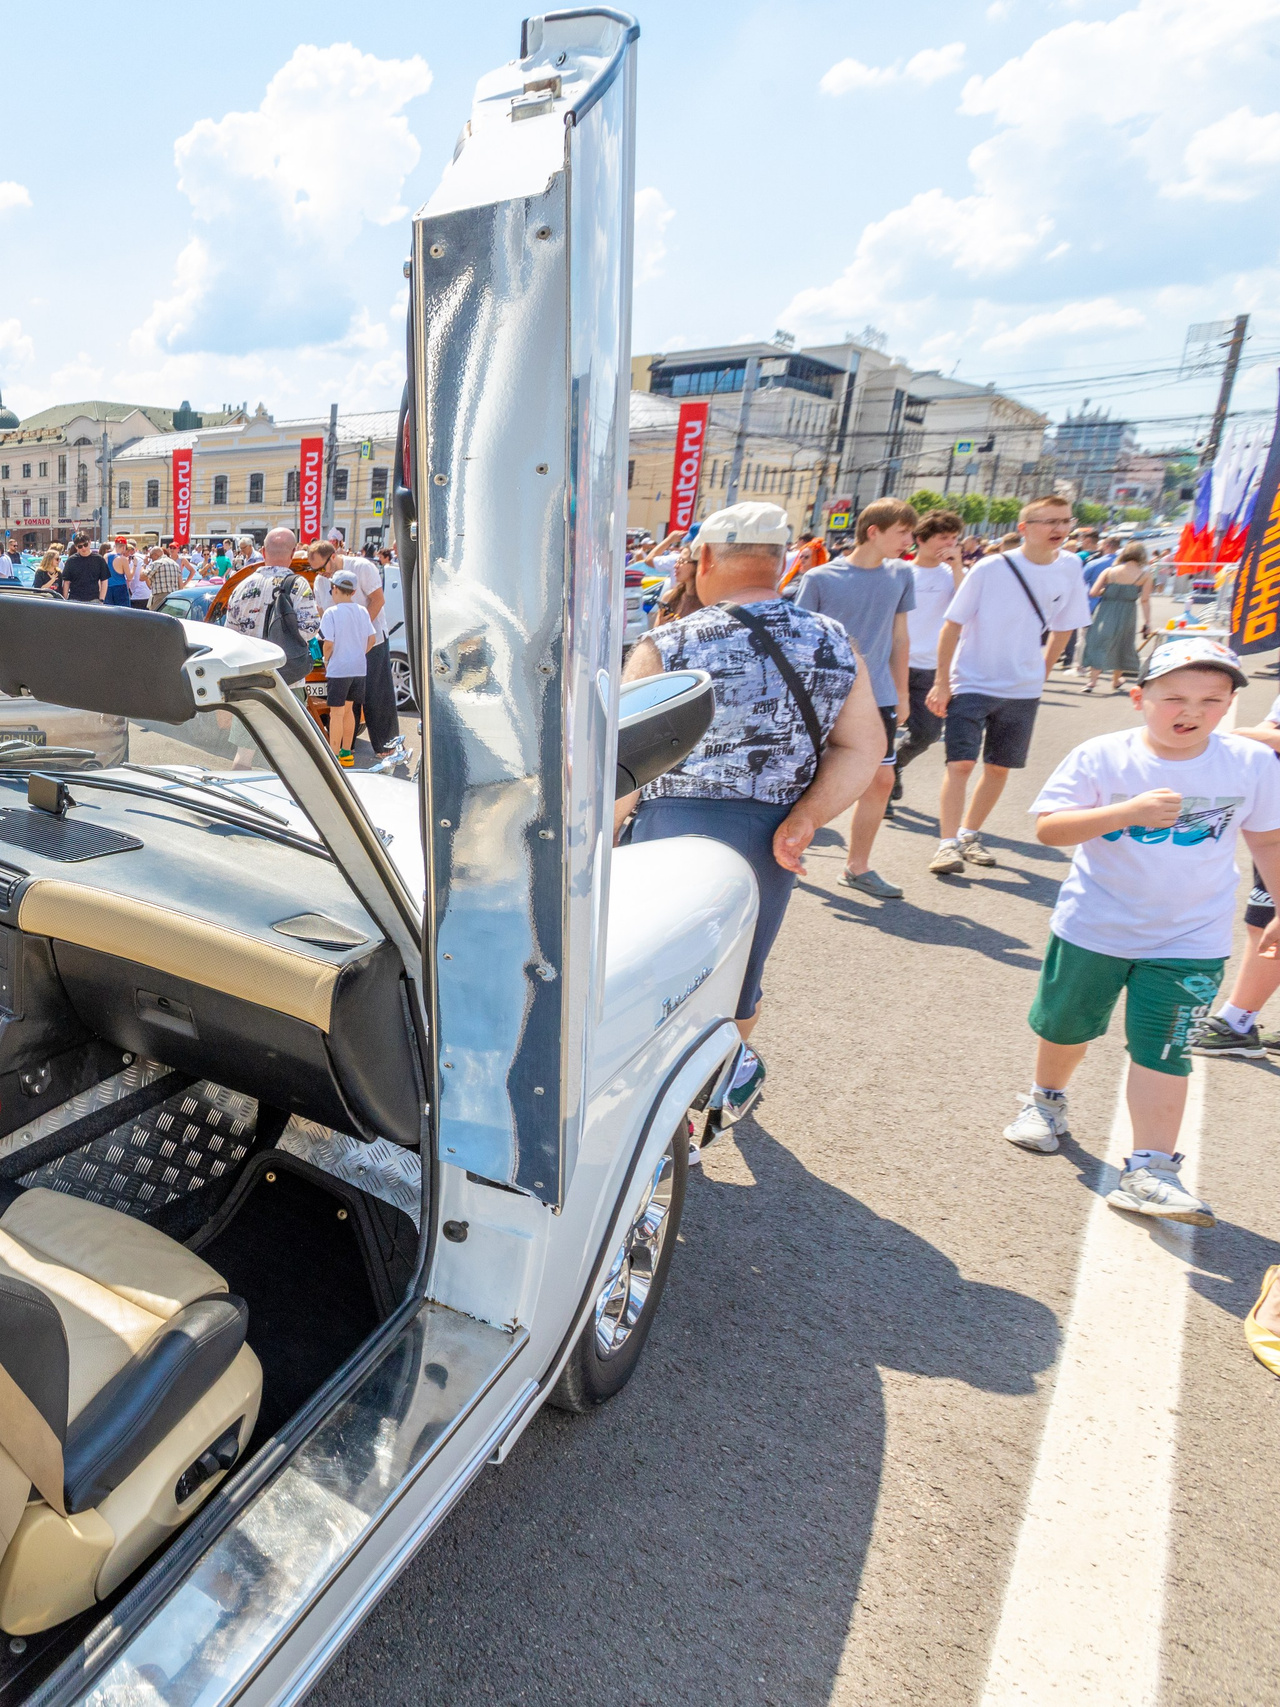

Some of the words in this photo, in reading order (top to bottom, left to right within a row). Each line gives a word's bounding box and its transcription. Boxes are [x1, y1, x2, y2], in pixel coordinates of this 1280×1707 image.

[177, 460, 190, 536] auto.ru
[302, 451, 319, 534] auto.ru
[676, 420, 702, 527] auto.ru
